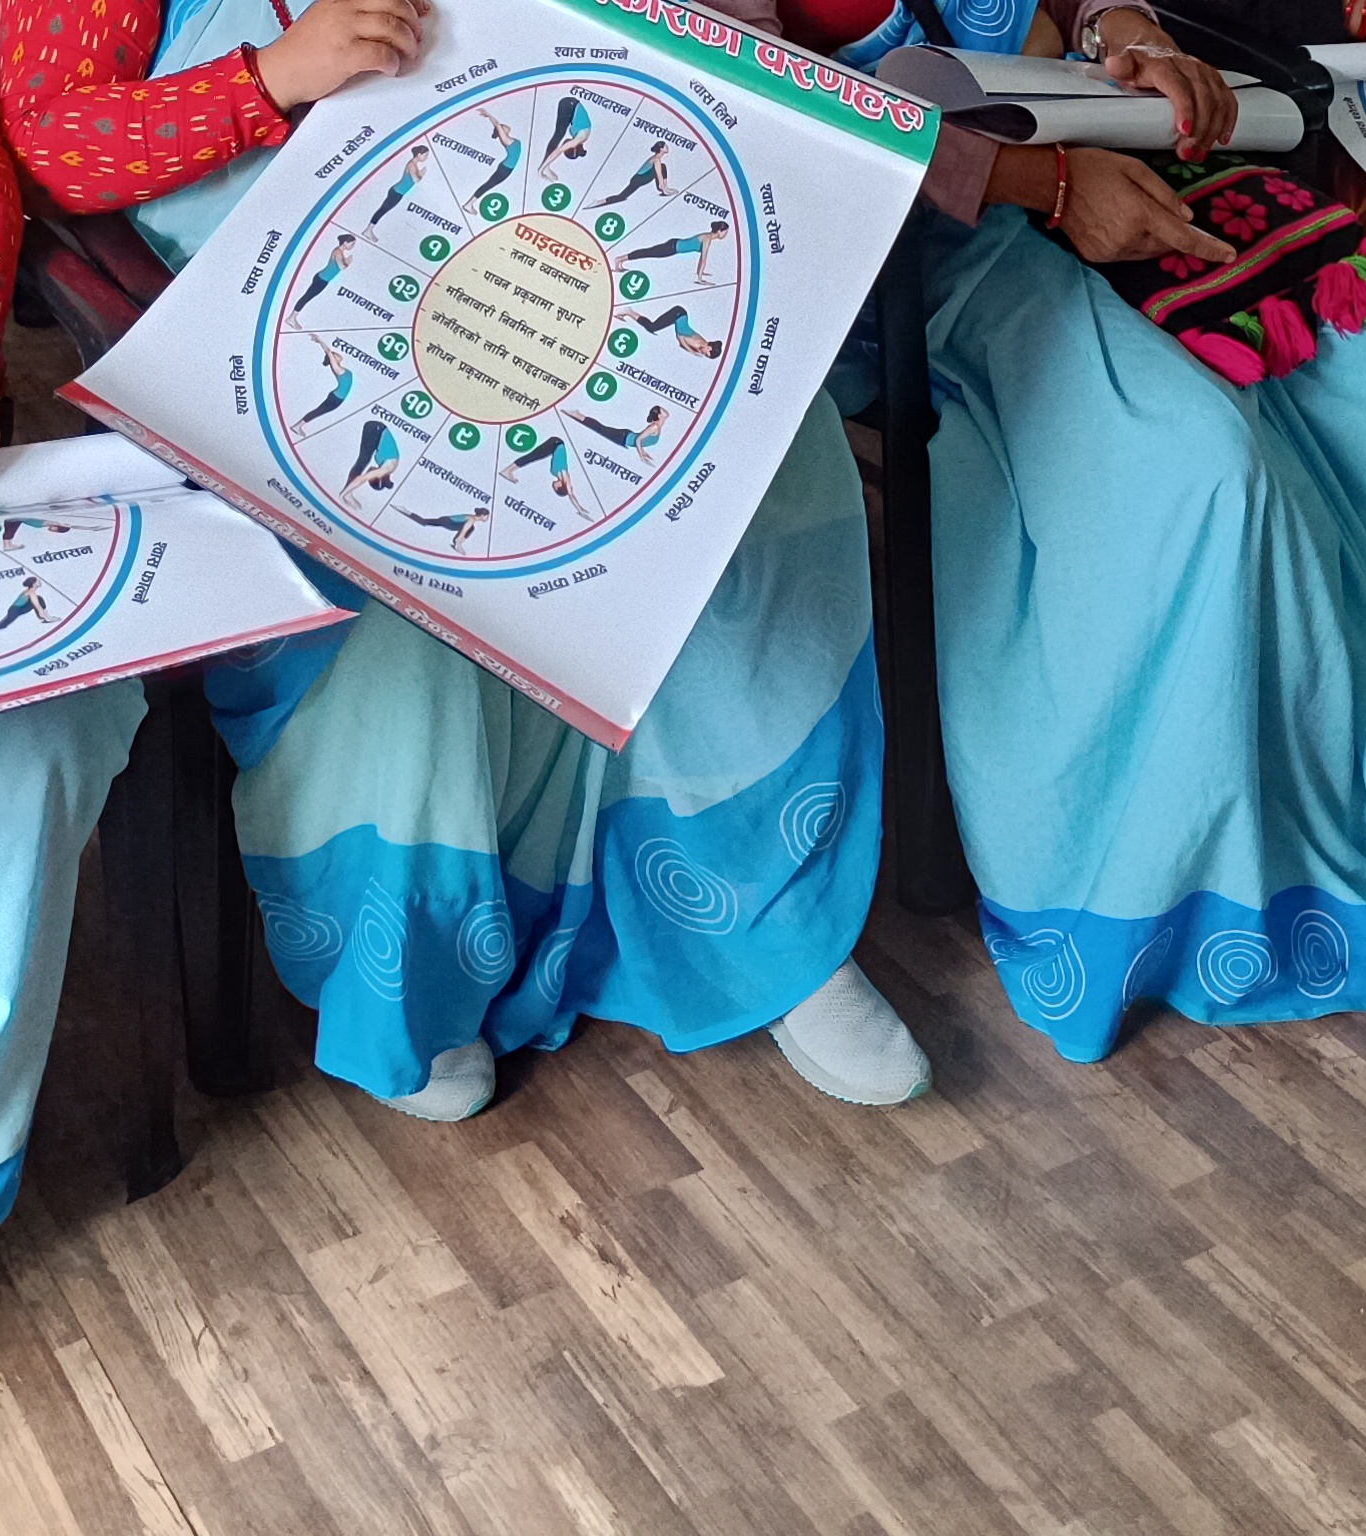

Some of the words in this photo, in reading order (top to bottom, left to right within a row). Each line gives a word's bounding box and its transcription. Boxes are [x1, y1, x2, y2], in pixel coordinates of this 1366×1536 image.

[554, 46, 585, 59] श्वास
[435, 73, 467, 93] श्वास
[468, 59, 498, 80] लिने
[711, 101, 738, 130] लिने
[314, 154, 344, 180] श्वास
[487, 199, 502, 216] २
[549, 189, 565, 207] ३
[759, 183, 775, 216] श्वास
[601, 217, 618, 235] ४
[429, 240, 441, 257] १
[511, 248, 536, 267] तनाव
[392, 277, 418, 300] १२
[627, 275, 644, 295] ५
[484, 270, 511, 291] पाचन
[557, 306, 585, 329] सुधार
[381, 335, 408, 359] ११
[484, 339, 510, 360] लागि
[614, 333, 630, 353] ६
[593, 377, 609, 395] ७
[405, 393, 430, 415] १०
[513, 429, 532, 449] ८
